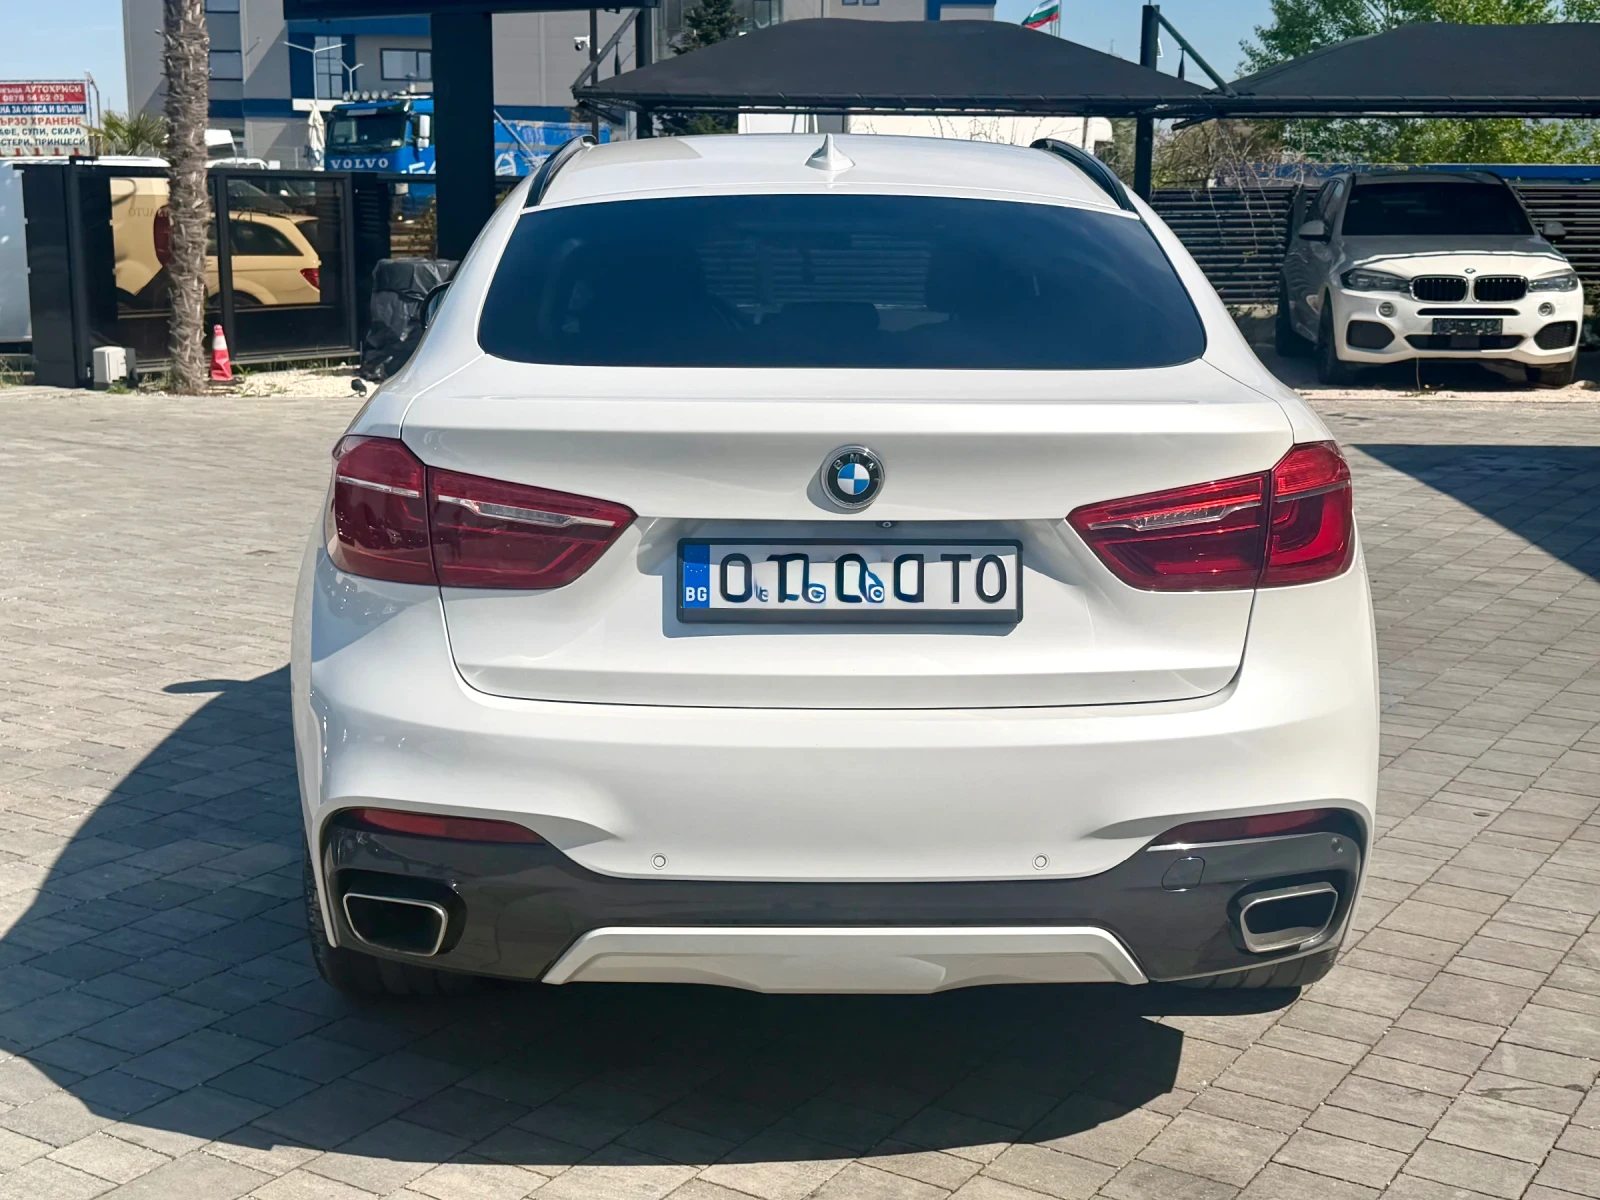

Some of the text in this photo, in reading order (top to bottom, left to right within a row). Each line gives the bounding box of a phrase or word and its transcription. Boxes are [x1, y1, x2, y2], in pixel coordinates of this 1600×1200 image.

[25, 84, 82, 93] АУТОХРИСИ
[11, 105, 21, 114] ЗА
[22, 104, 48, 113] ОФИСА
[49, 105, 55, 113] И
[31, 116, 81, 126] ХРАНЕНЕ
[22, 127, 49, 136] СУПИ,
[51, 127, 82, 136] СКАРА
[35, 138, 86, 147] ПРИНЦЕСИ
[330, 158, 389, 169] VOLVO
[832, 453, 877, 472] BMW
[685, 586, 708, 602] BG
